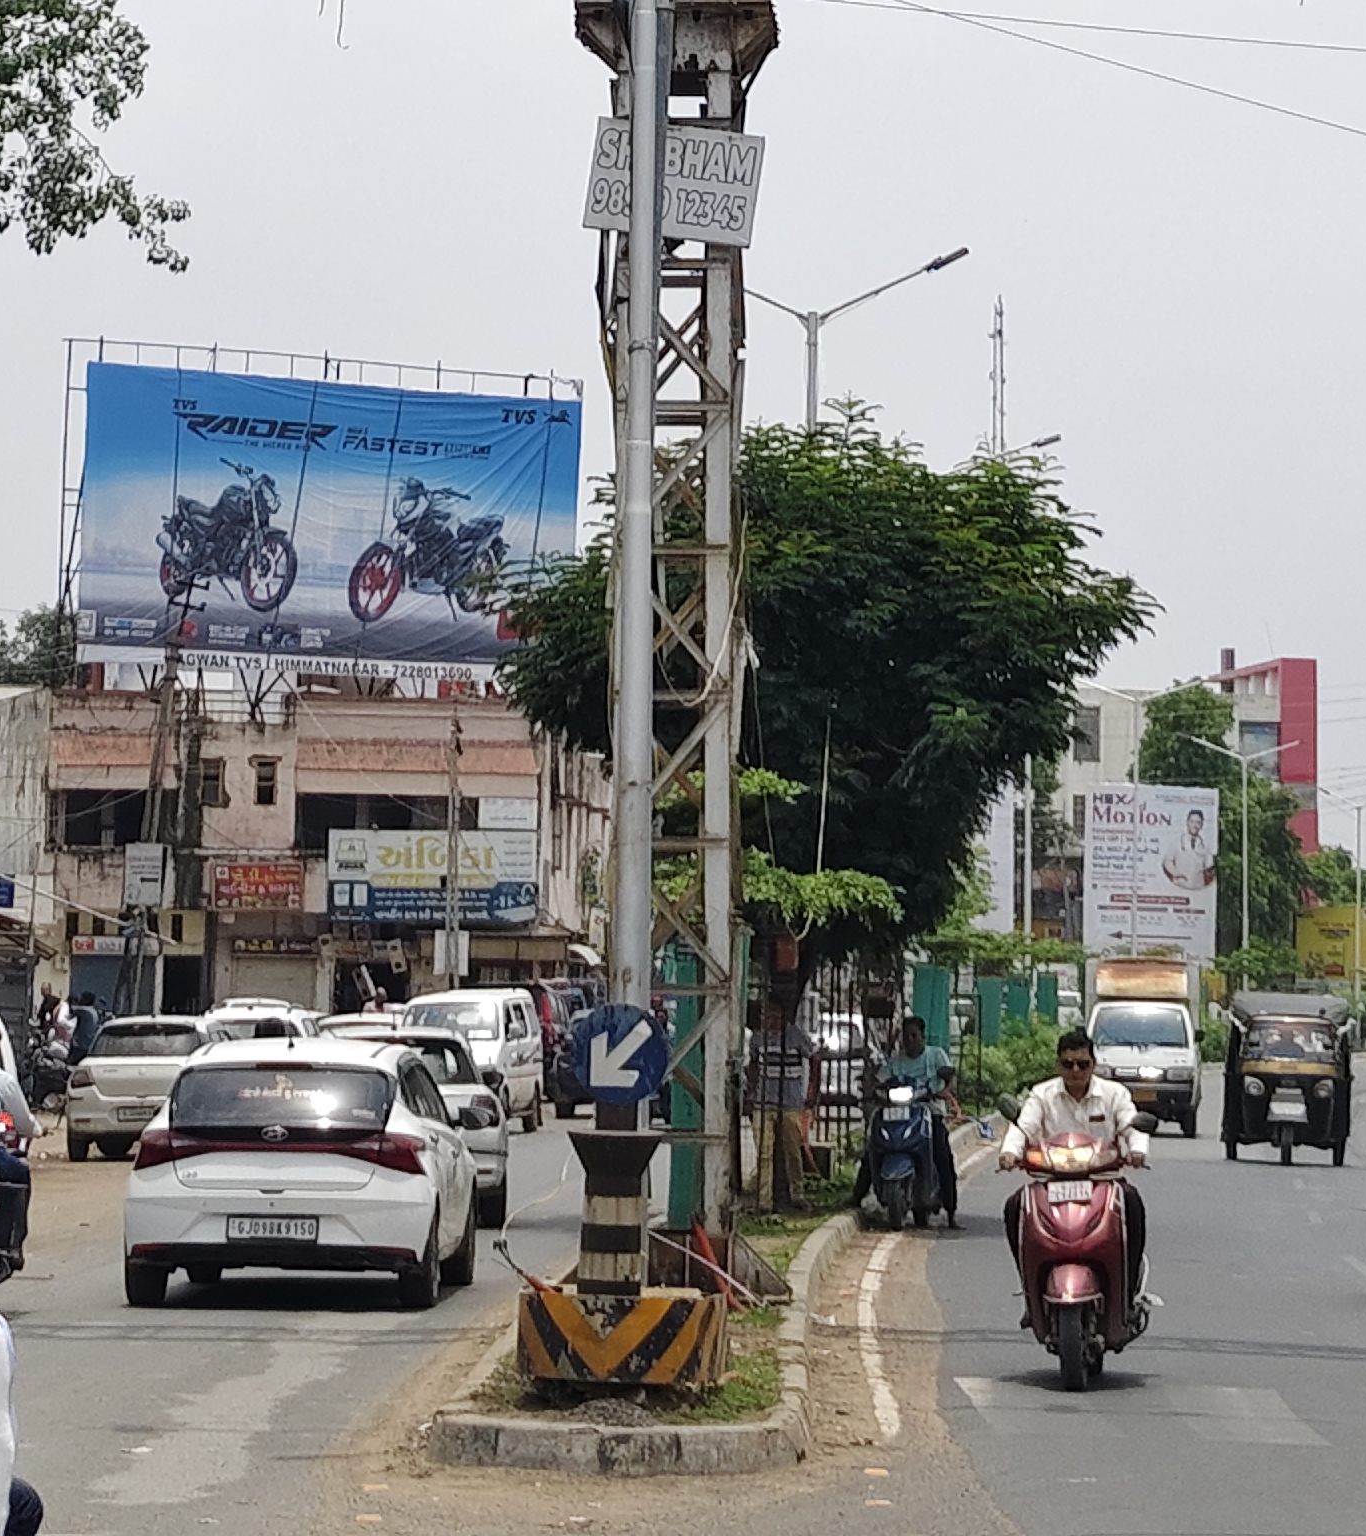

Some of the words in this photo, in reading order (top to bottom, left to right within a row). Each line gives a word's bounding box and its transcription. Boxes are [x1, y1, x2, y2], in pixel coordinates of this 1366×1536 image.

[596, 127, 757, 186] SHBHAM
[676, 188, 748, 231] 12345
[172, 397, 198, 411] TVS
[500, 408, 538, 425] TVS
[172, 412, 339, 451] RAIDER
[342, 434, 444, 457] FASTEST
[233, 656, 262, 670] TVS
